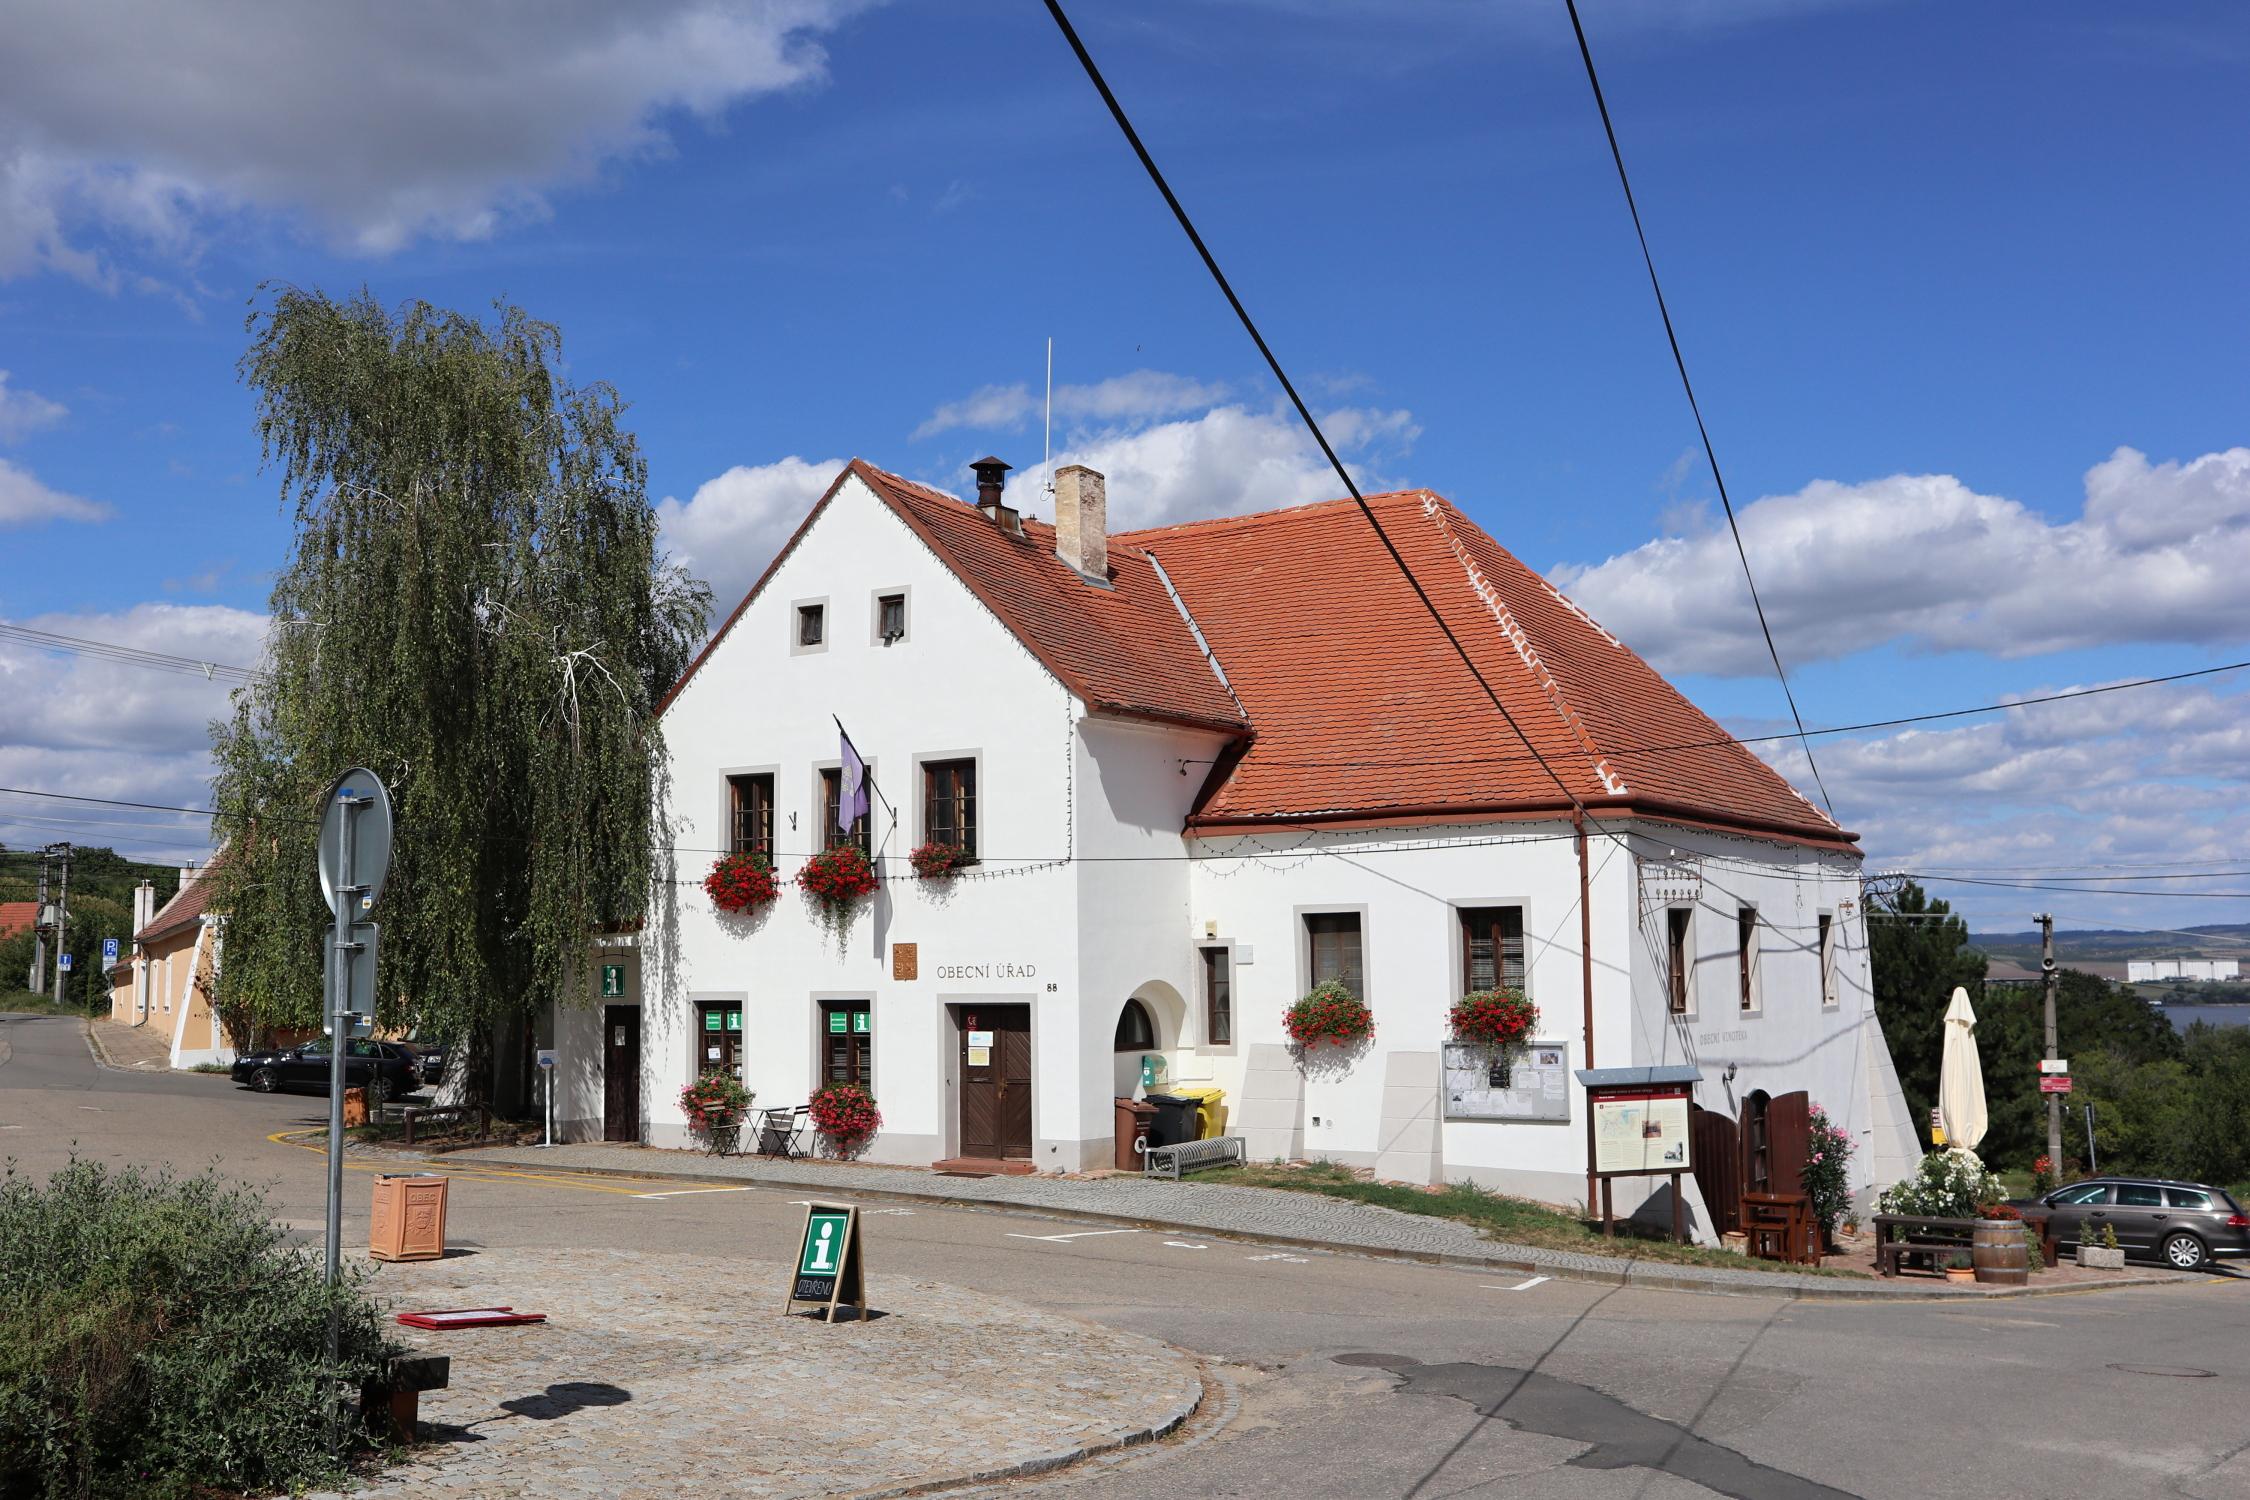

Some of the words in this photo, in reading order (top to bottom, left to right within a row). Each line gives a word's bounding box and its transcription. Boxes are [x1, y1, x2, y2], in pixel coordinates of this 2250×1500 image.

[107, 941, 115, 952] P
[937, 963, 990, 979] OBECNÍ
[996, 962, 1036, 978] ÚŘAD
[1046, 983, 1058, 992] 88
[857, 1013, 868, 1031] i
[409, 1192, 436, 1202] OBEC
[797, 1279, 832, 1295] OTEVŘENO
